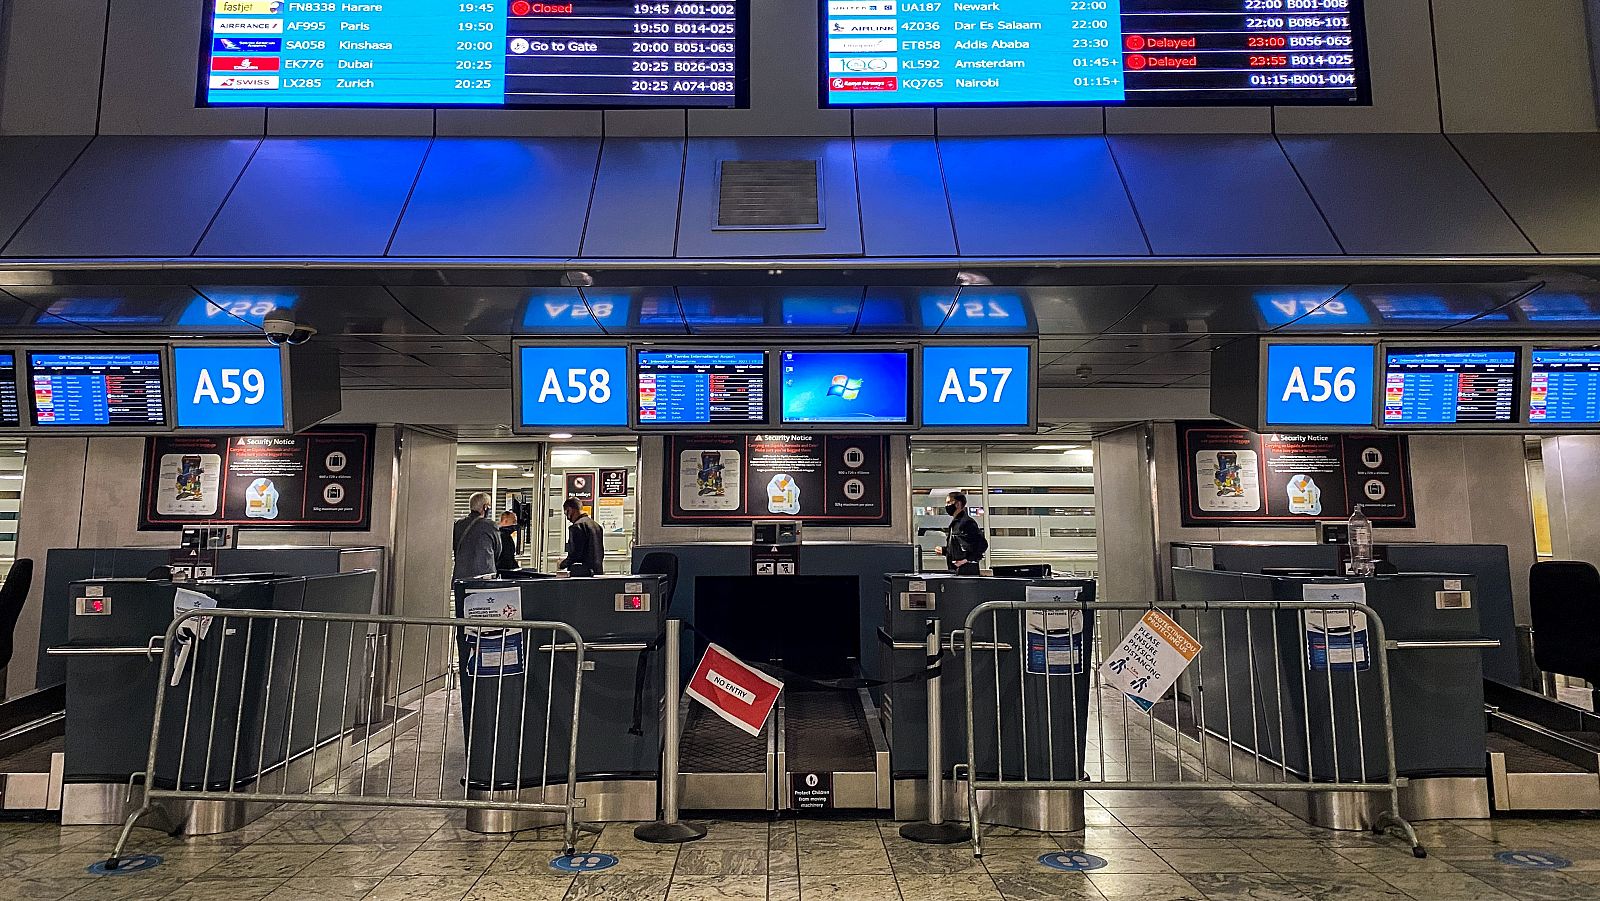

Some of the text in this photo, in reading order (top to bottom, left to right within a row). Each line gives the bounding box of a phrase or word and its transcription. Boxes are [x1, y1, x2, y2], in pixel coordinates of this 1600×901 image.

[223, 2, 253, 12] fastjet
[289, 2, 494, 12] FN8338 Harare 19:45
[532, 4, 734, 14] Closed 19:45 A001-002
[901, 0, 1107, 12] UA187 Newark 22:00
[1245, 0, 1348, 8] 22:00 B001-008
[287, 22, 494, 32] AF995 Paris 19:50
[633, 24, 734, 34] 19:50 B014-025
[901, 20, 1108, 31] 4Z036 Dar Es Salaam 22:00
[1246, 18, 1349, 28] 22:00 B086-101
[286, 40, 326, 50] SA058
[340, 40, 392, 50] Kinshasa
[456, 41, 493, 50] 20:00
[530, 42, 734, 52] Go to Gate 20:00 B051-063
[902, 39, 1108, 50] ET858 Addis Ababa 23:30
[1148, 36, 1351, 48] Delayed 23:00 B056-063
[284, 60, 492, 70] EK776 Dubai 20:25
[632, 62, 734, 72] 20:25 B026-033
[902, 58, 1119, 70] KL592 Amsterdam 01:45+
[1149, 55, 1352, 68] Delayed 23:55 B014-025
[284, 78, 492, 90] LX285 Zurich 20:25
[632, 81, 734, 92] 20:25 A074-083
[902, 77, 1120, 89] KQ765 Nairobi 01:15+
[192, 368, 264, 404] A59
[538, 368, 611, 404] A58
[938, 367, 1012, 404] A57
[1282, 366, 1356, 402] A56
[1148, 617, 1180, 647] PROTECTING
[1151, 612, 1184, 642] PROTECTING
[1138, 627, 1160, 648] PLEASE
[1133, 633, 1157, 656] ENSURE
[1129, 639, 1156, 666] PHYSICAL
[1123, 645, 1160, 679] DISTANCING
[714, 676, 747, 698] NO ENTRY
